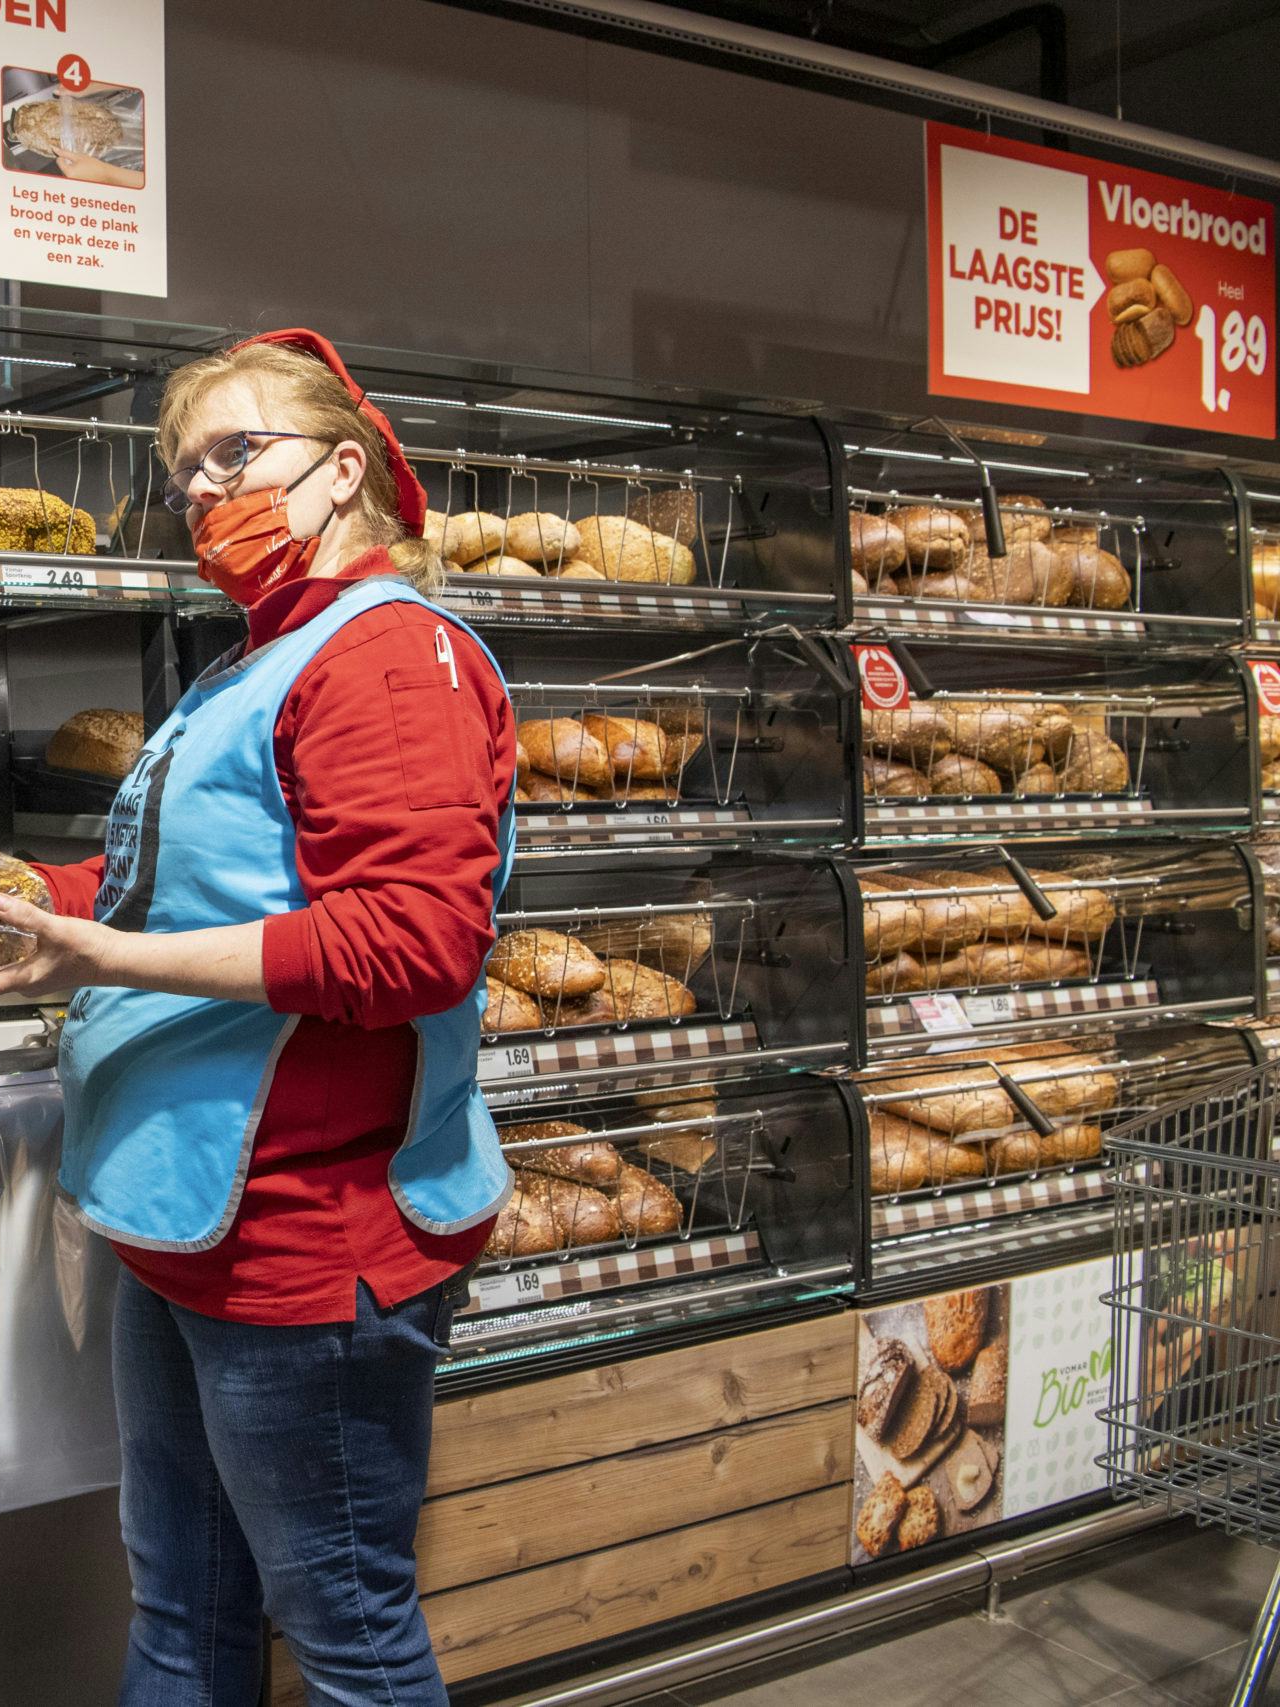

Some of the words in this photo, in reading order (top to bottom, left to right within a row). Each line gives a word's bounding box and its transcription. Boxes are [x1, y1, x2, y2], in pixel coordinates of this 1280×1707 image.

[63, 61, 83, 86] 4
[12, 186, 39, 203] Leg
[43, 189, 66, 204] het
[70, 195, 136, 214] gesneden
[10, 205, 53, 222] brood
[57, 213, 76, 227] op
[80, 214, 98, 228] de
[101, 217, 139, 234] plank
[998, 205, 1039, 246] DE
[1098, 179, 1267, 256] Vloerbrood
[13, 227, 31, 239] en
[35, 228, 82, 246] verpak
[86, 235, 120, 251] deze
[123, 239, 136, 253] in
[47, 251, 72, 264] een
[76, 253, 104, 268] zak.
[948, 244, 1085, 300] LAAGSTE
[1217, 280, 1245, 301] Heel
[973, 295, 1063, 342] PRIJS!
[1195, 303, 1268, 413] 1.89
[505, 1048, 530, 1066] 1.69
[515, 1272, 540, 1293] 1.69
[1060, 1361, 1088, 1375] VOMAR
[1032, 1367, 1089, 1429] Bio
